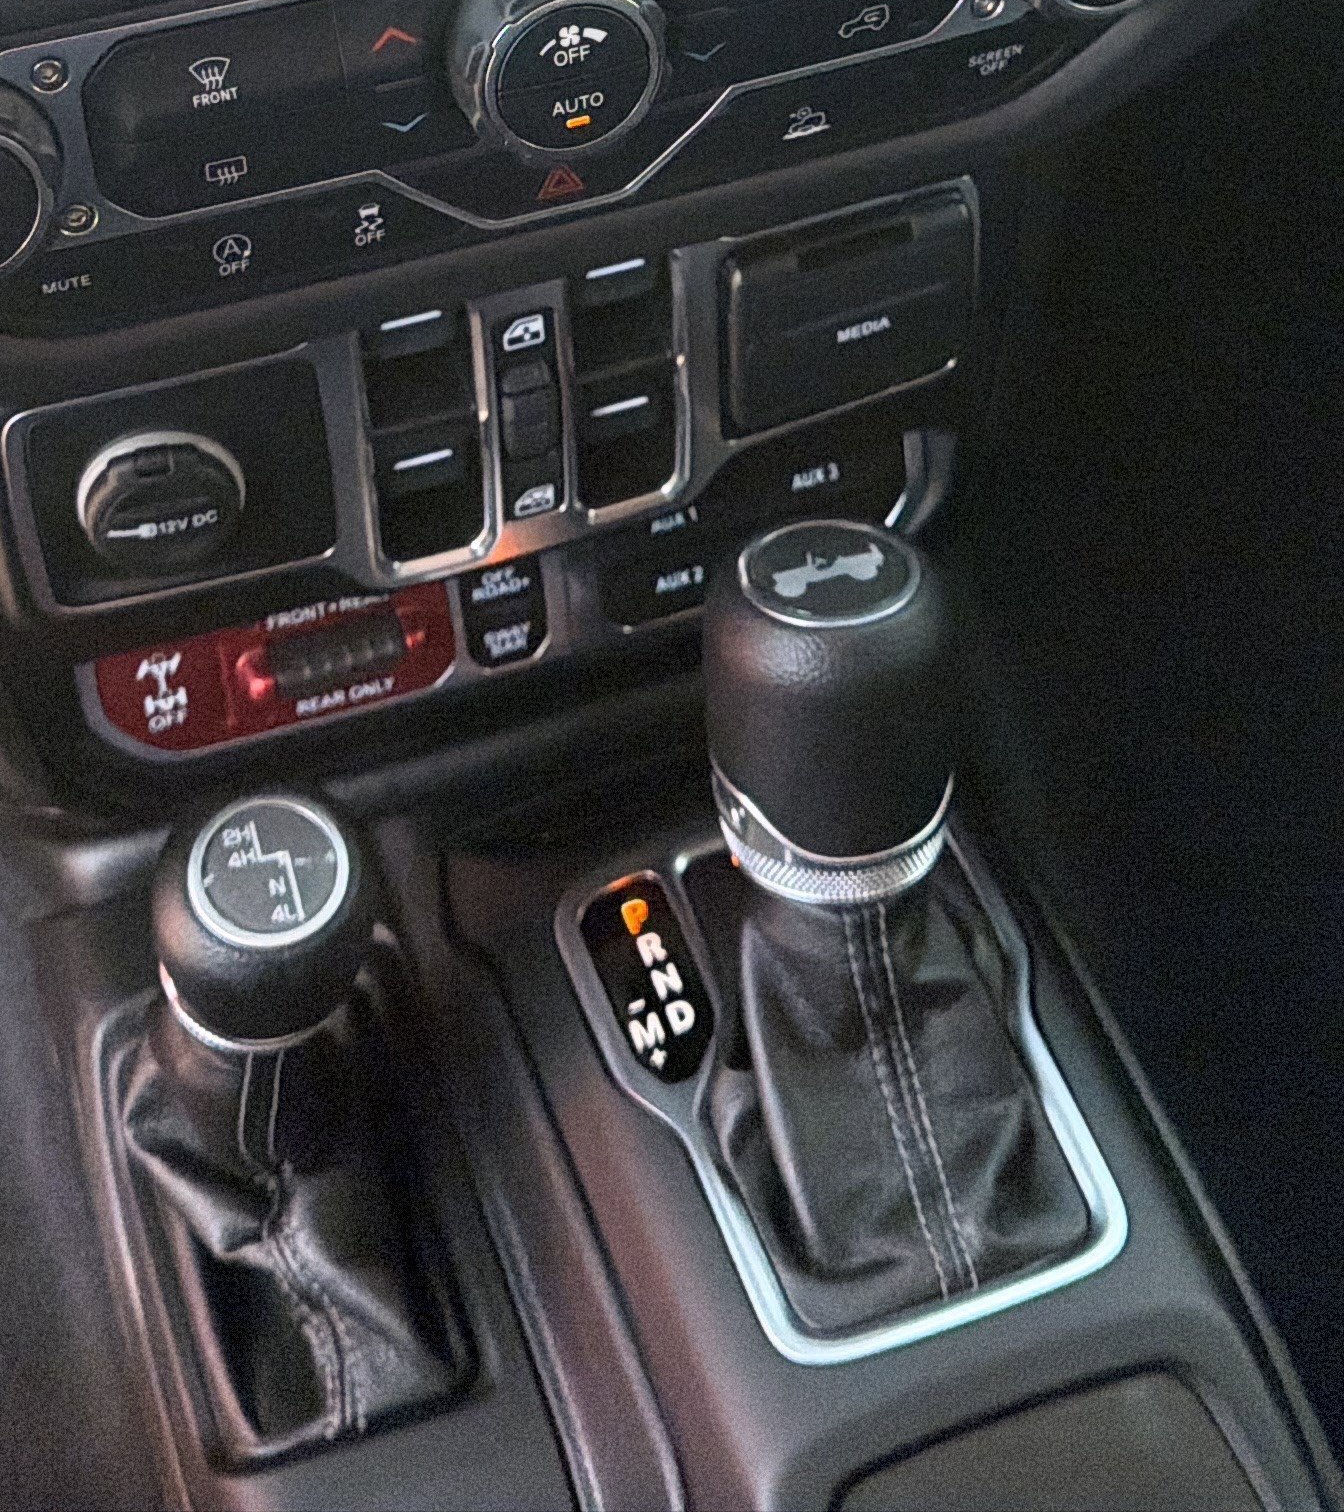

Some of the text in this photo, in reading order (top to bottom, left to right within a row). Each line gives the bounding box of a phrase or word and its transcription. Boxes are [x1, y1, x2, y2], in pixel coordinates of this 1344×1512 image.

[554, 44, 591, 67] OFF
[968, 44, 1024, 68] SCREEN
[980, 58, 1009, 76] OFF
[192, 86, 239, 109] FRONT
[552, 92, 604, 117] AUTO
[355, 229, 386, 247] OFF
[219, 259, 250, 277] OFF
[41, 274, 93, 295] MUTE
[837, 316, 890, 343] MEDIA
[791, 467, 824, 490] AUX
[193, 509, 218, 528] DC
[656, 569, 690, 593] AUX
[269, 875, 286, 898] N
[621, 898, 648, 935] P
[636, 932, 667, 967] R
[651, 962, 683, 1001] N
[665, 1000, 696, 1036] D
[628, 1011, 666, 1054] M
